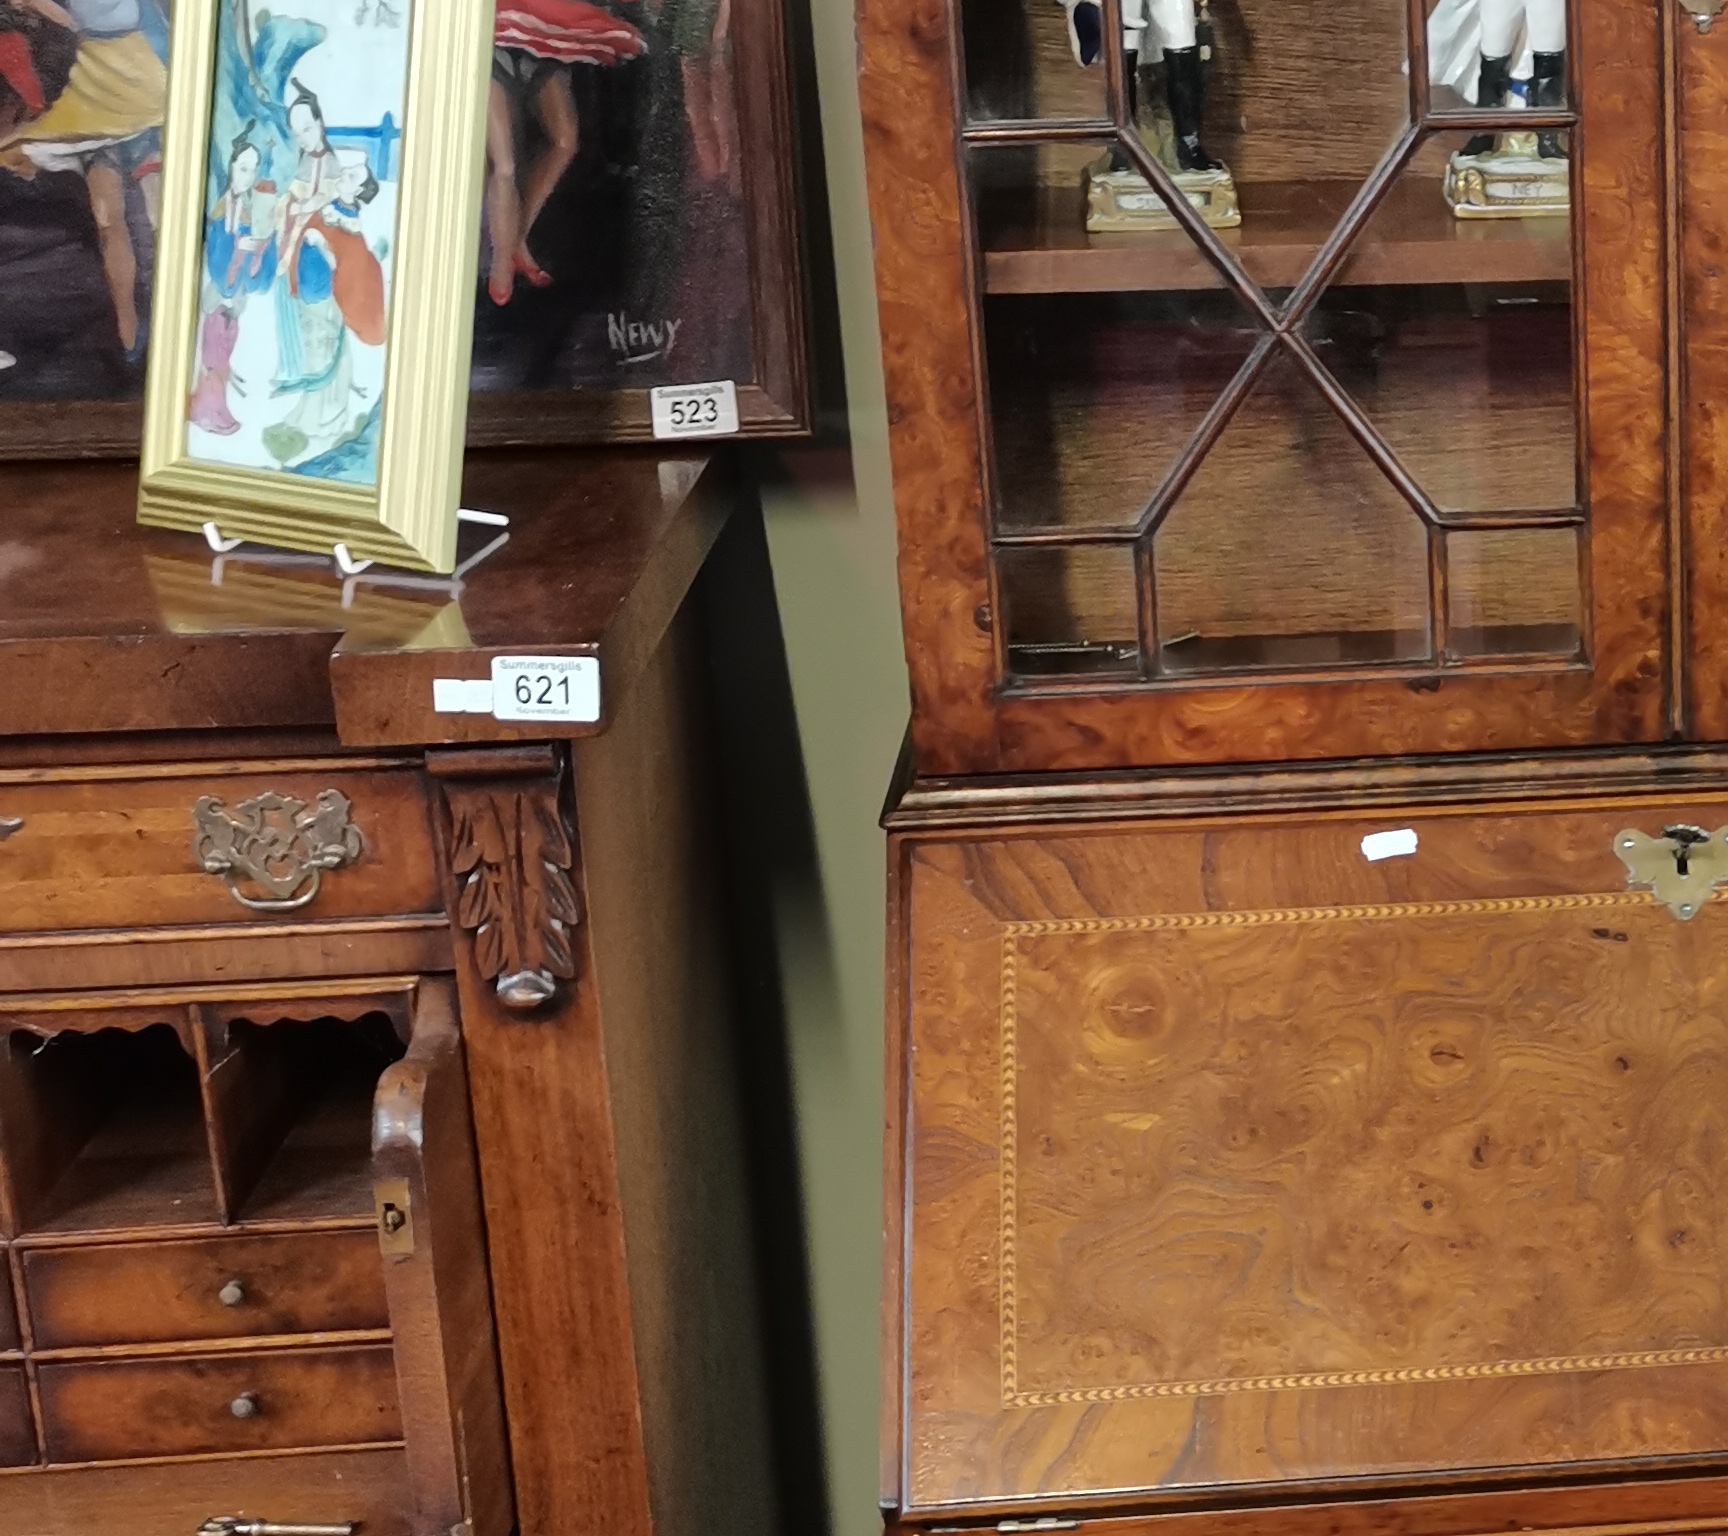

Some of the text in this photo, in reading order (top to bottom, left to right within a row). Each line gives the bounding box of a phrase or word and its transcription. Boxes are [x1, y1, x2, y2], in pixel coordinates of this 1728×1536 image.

[670, 398, 718, 425] 523
[500, 659, 582, 673] Summersgills
[515, 675, 570, 705] 621
